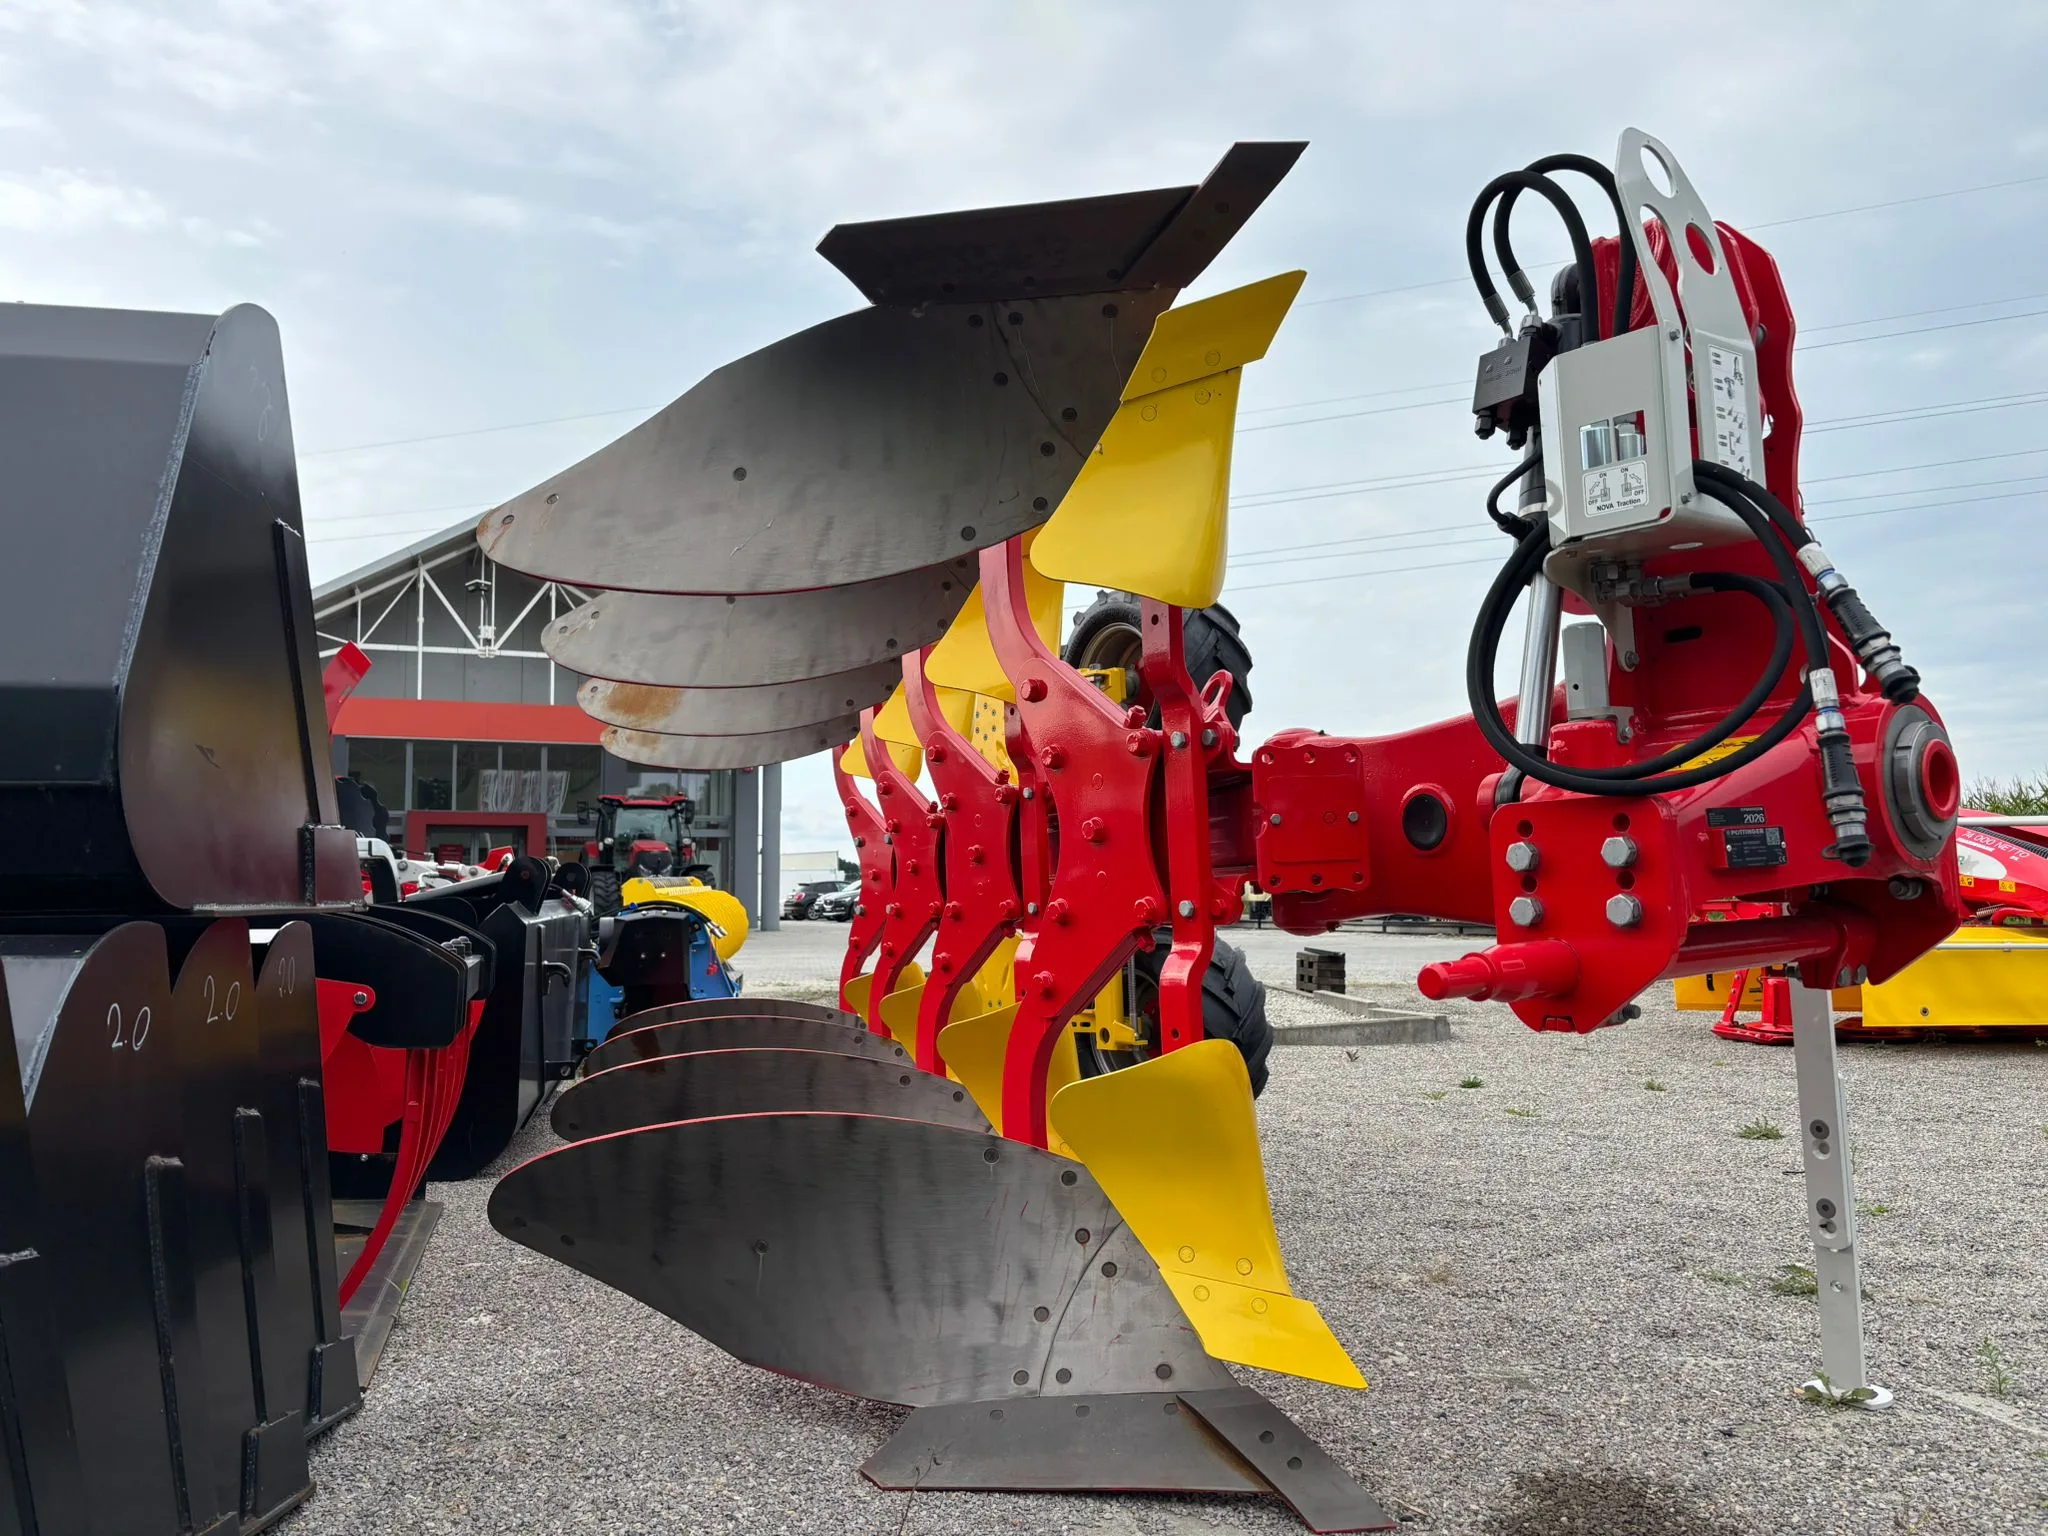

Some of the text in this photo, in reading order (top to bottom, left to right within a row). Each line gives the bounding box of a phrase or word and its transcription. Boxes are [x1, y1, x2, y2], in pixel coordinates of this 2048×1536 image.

[1597, 499, 1641, 511] NOVA Traction
[1743, 813, 1765, 824] 2026
[1993, 840, 2031, 859] NETTO
[203, 974, 241, 1024] 2.0
[106, 1002, 151, 1051] 2.0
